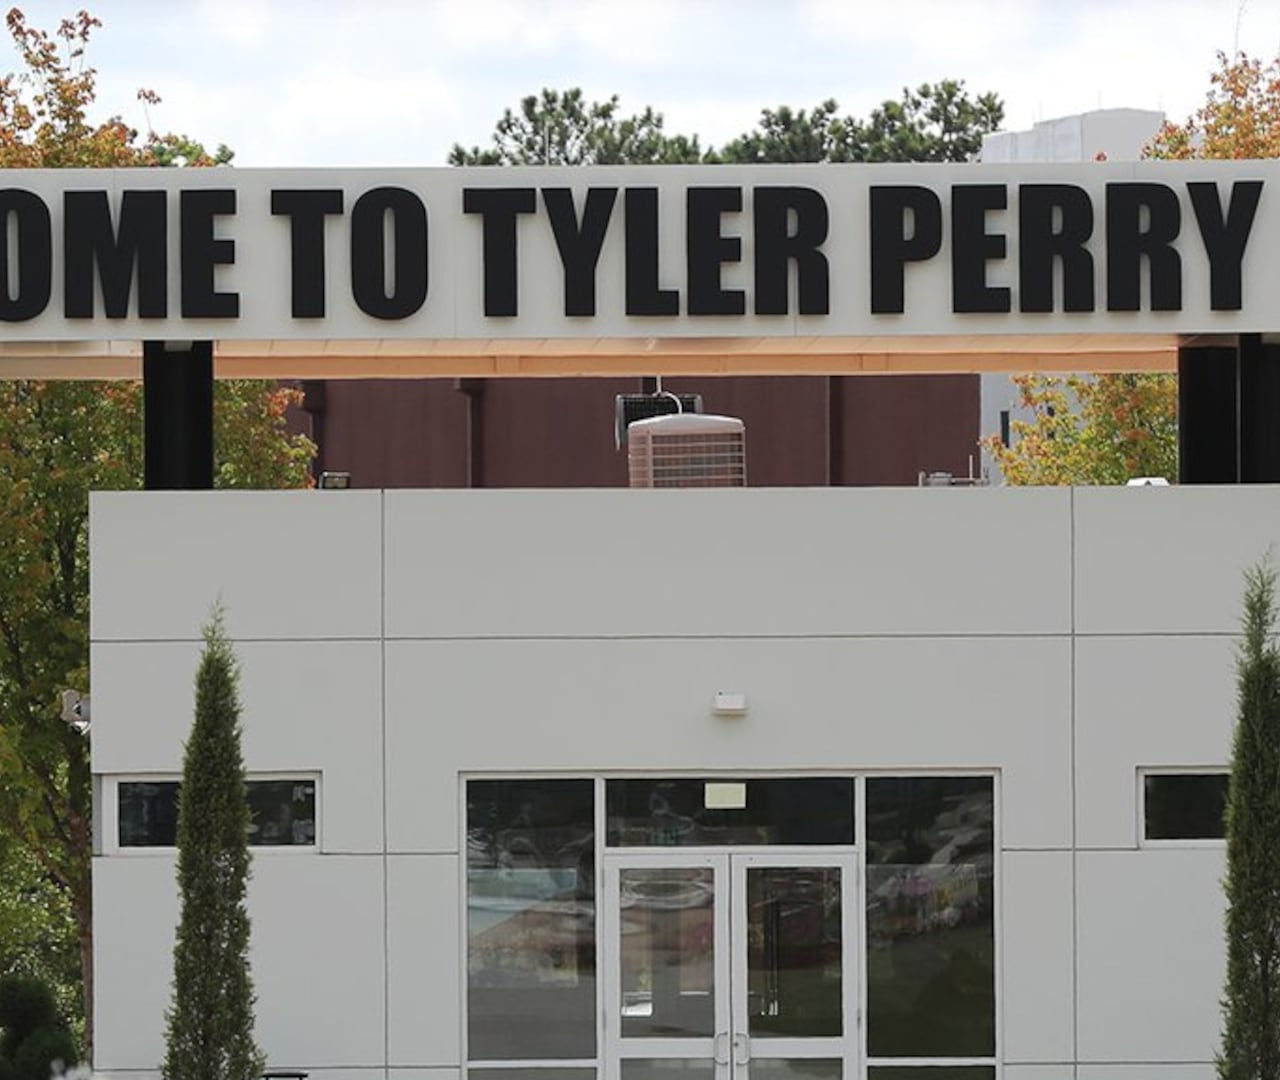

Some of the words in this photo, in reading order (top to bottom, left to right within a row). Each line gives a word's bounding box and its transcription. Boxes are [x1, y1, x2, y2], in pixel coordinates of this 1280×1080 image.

[271, 187, 429, 320] TO
[463, 186, 830, 317] TYLER
[869, 182, 1265, 314] PERRY
